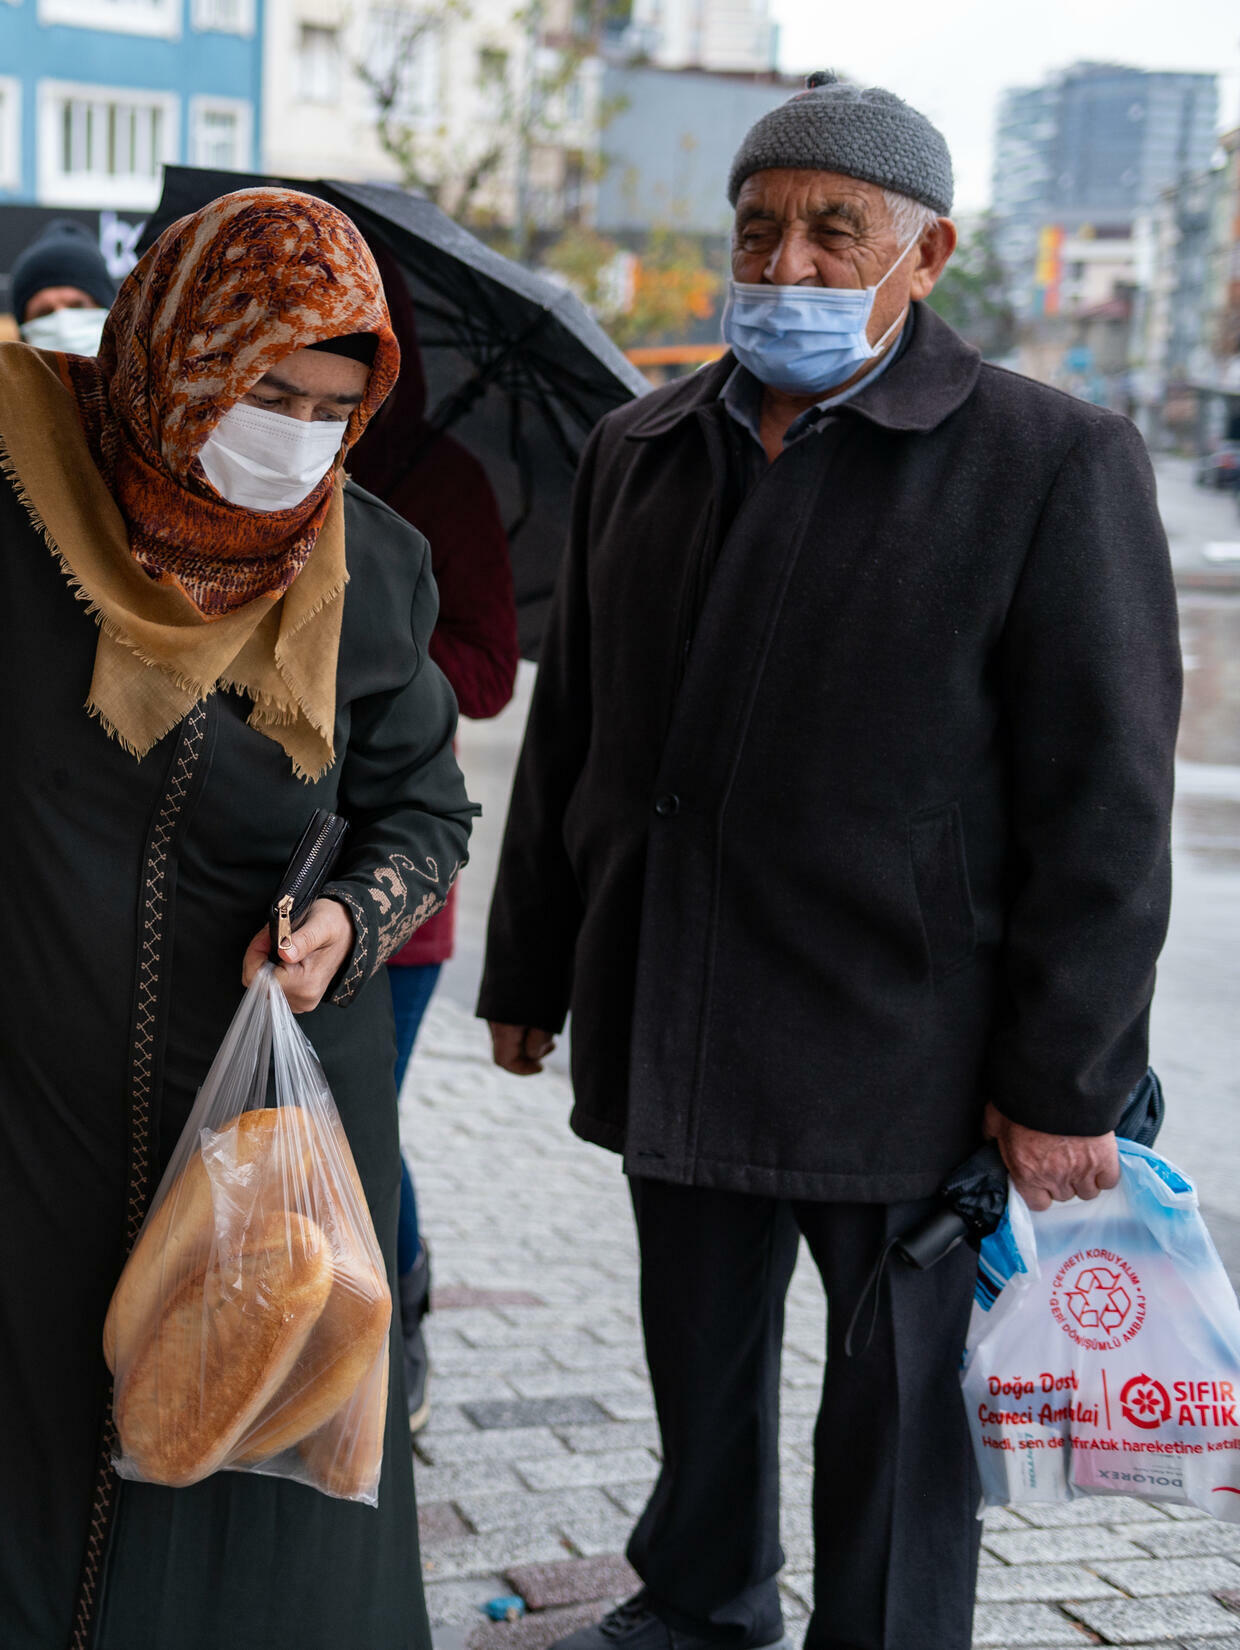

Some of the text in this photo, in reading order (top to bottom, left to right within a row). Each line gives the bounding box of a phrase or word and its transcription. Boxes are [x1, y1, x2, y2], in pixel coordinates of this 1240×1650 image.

[1052, 1248, 1140, 1288] ÇEVREYİ KORUYALIM
[1123, 1295, 1146, 1343] AMBALAJ
[988, 1375, 1035, 1400] Doğa
[1173, 1381, 1236, 1402] SIFIR
[978, 1399, 1099, 1428] Çevreci Amlaj
[1178, 1404, 1240, 1427] ATIK
[1018, 1438, 1045, 1450] sen
[1047, 1436, 1065, 1449] de
[1098, 1469, 1184, 1488] DOLOREX
